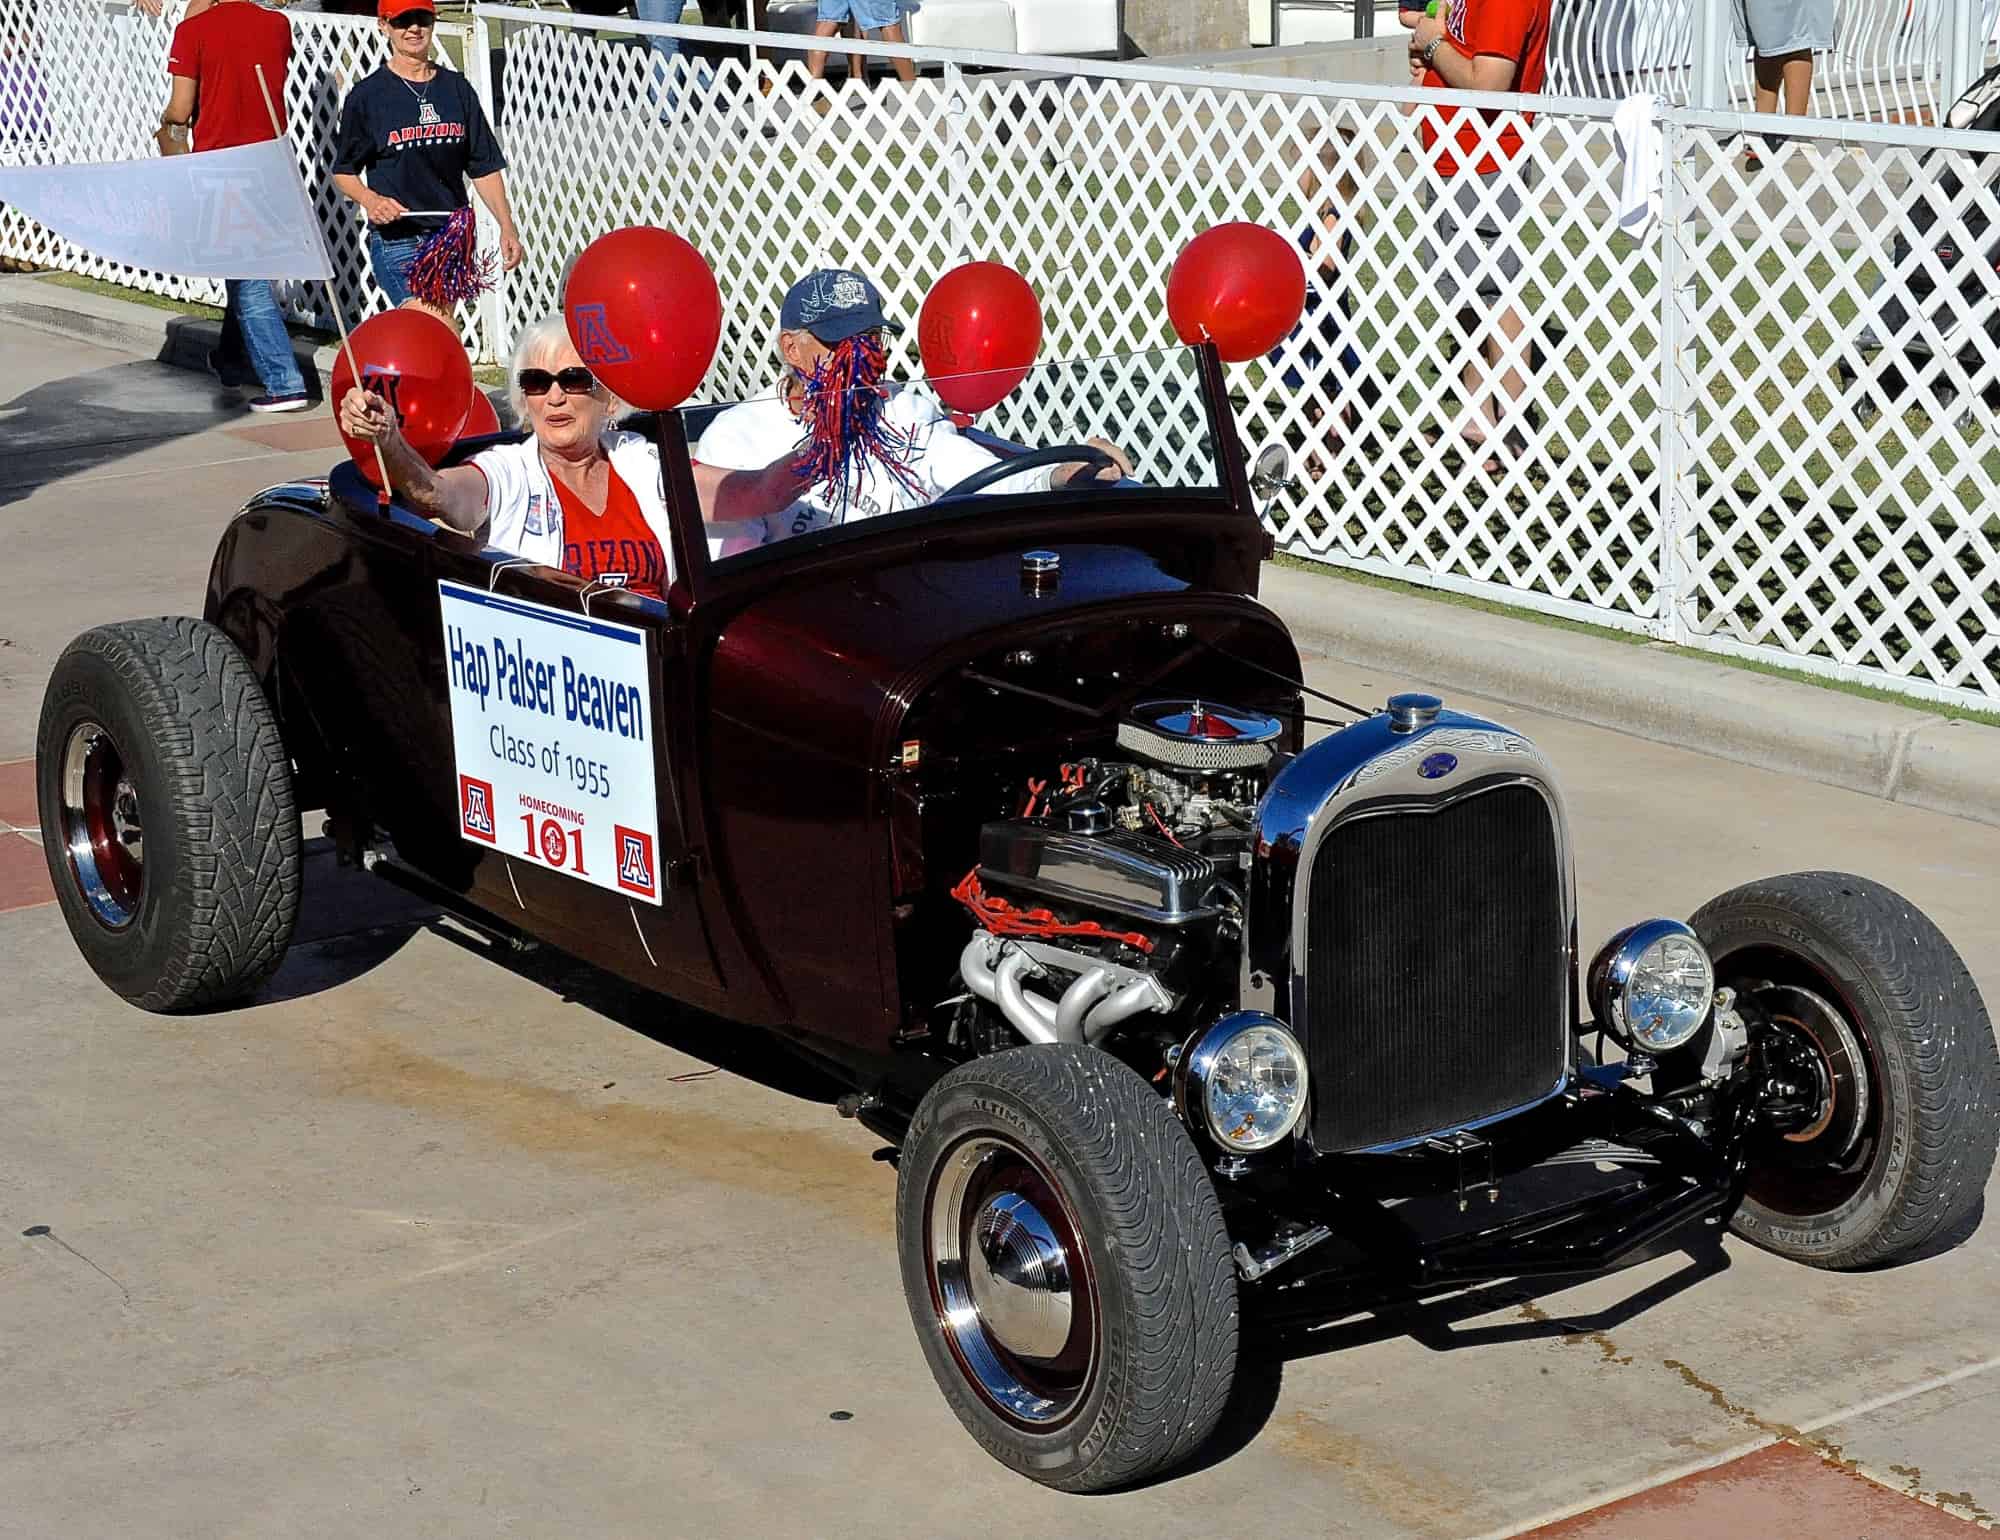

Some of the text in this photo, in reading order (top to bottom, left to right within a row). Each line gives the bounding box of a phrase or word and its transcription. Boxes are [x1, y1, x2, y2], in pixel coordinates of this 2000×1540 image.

[419, 104, 441, 124] A
[575, 304, 632, 364] A
[564, 539, 660, 583] RIZON
[448, 624, 645, 741] Hap Palser Beaven
[489, 724, 611, 798] Class of 1955
[466, 787, 491, 833] A
[518, 793, 585, 826] HOMECOMING
[520, 813, 589, 876] 101
[622, 837, 649, 886] A
[971, 1098, 1042, 1142] ALTIMAX
